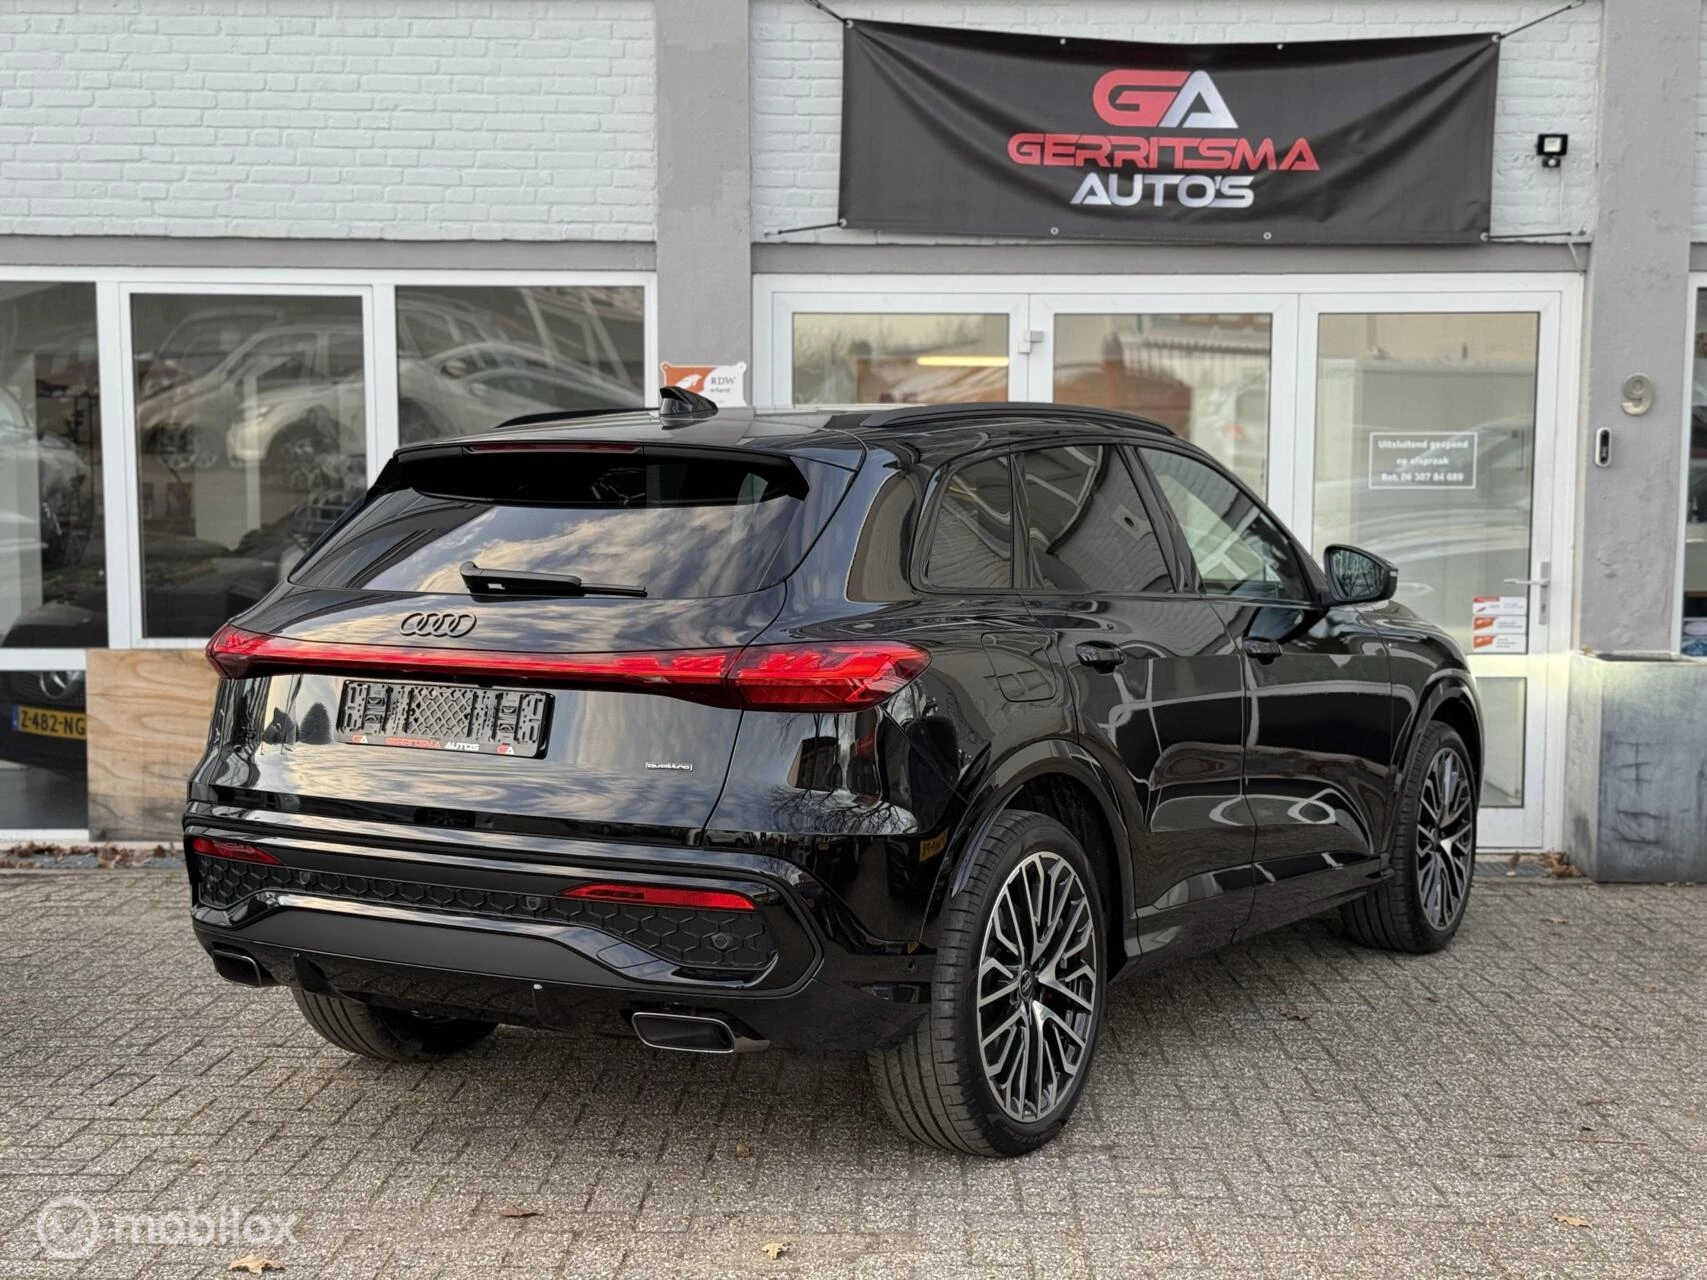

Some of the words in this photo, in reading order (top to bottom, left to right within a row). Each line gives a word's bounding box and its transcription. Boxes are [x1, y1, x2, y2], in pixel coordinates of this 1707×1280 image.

[1092, 69, 1238, 128] GA
[1007, 133, 1320, 171] GERRITSMA
[1069, 172, 1254, 208] AUTO'S
[710, 376, 736, 385] RDW
[1622, 372, 1653, 417] 9
[21, 709, 86, 735] Z-482-NG
